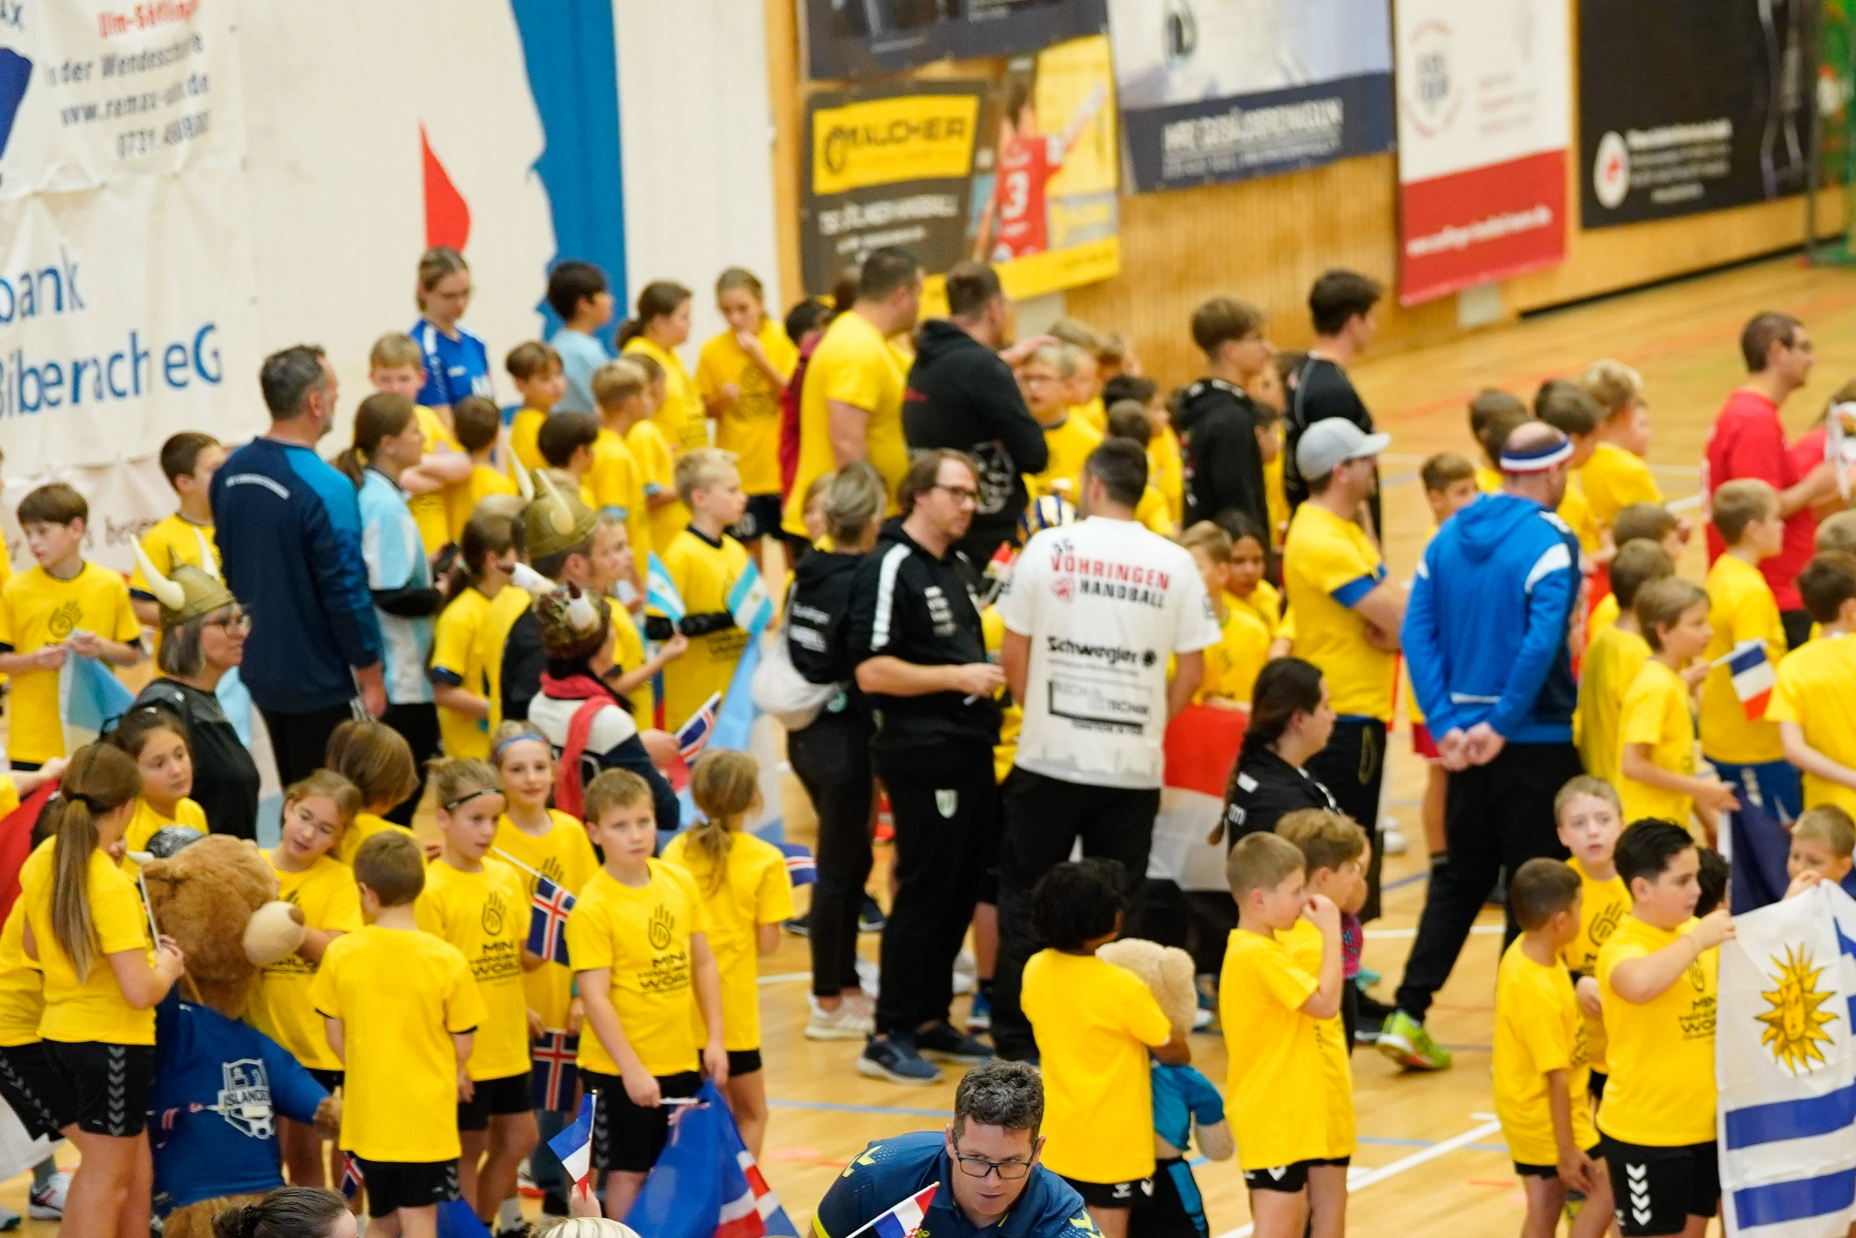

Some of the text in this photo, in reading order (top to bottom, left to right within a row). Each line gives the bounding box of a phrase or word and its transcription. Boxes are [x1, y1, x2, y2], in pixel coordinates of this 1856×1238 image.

[1001, 171, 1029, 219] 3
[163, 321, 222, 384] eG
[1080, 579, 1165, 609] HANDBALL
